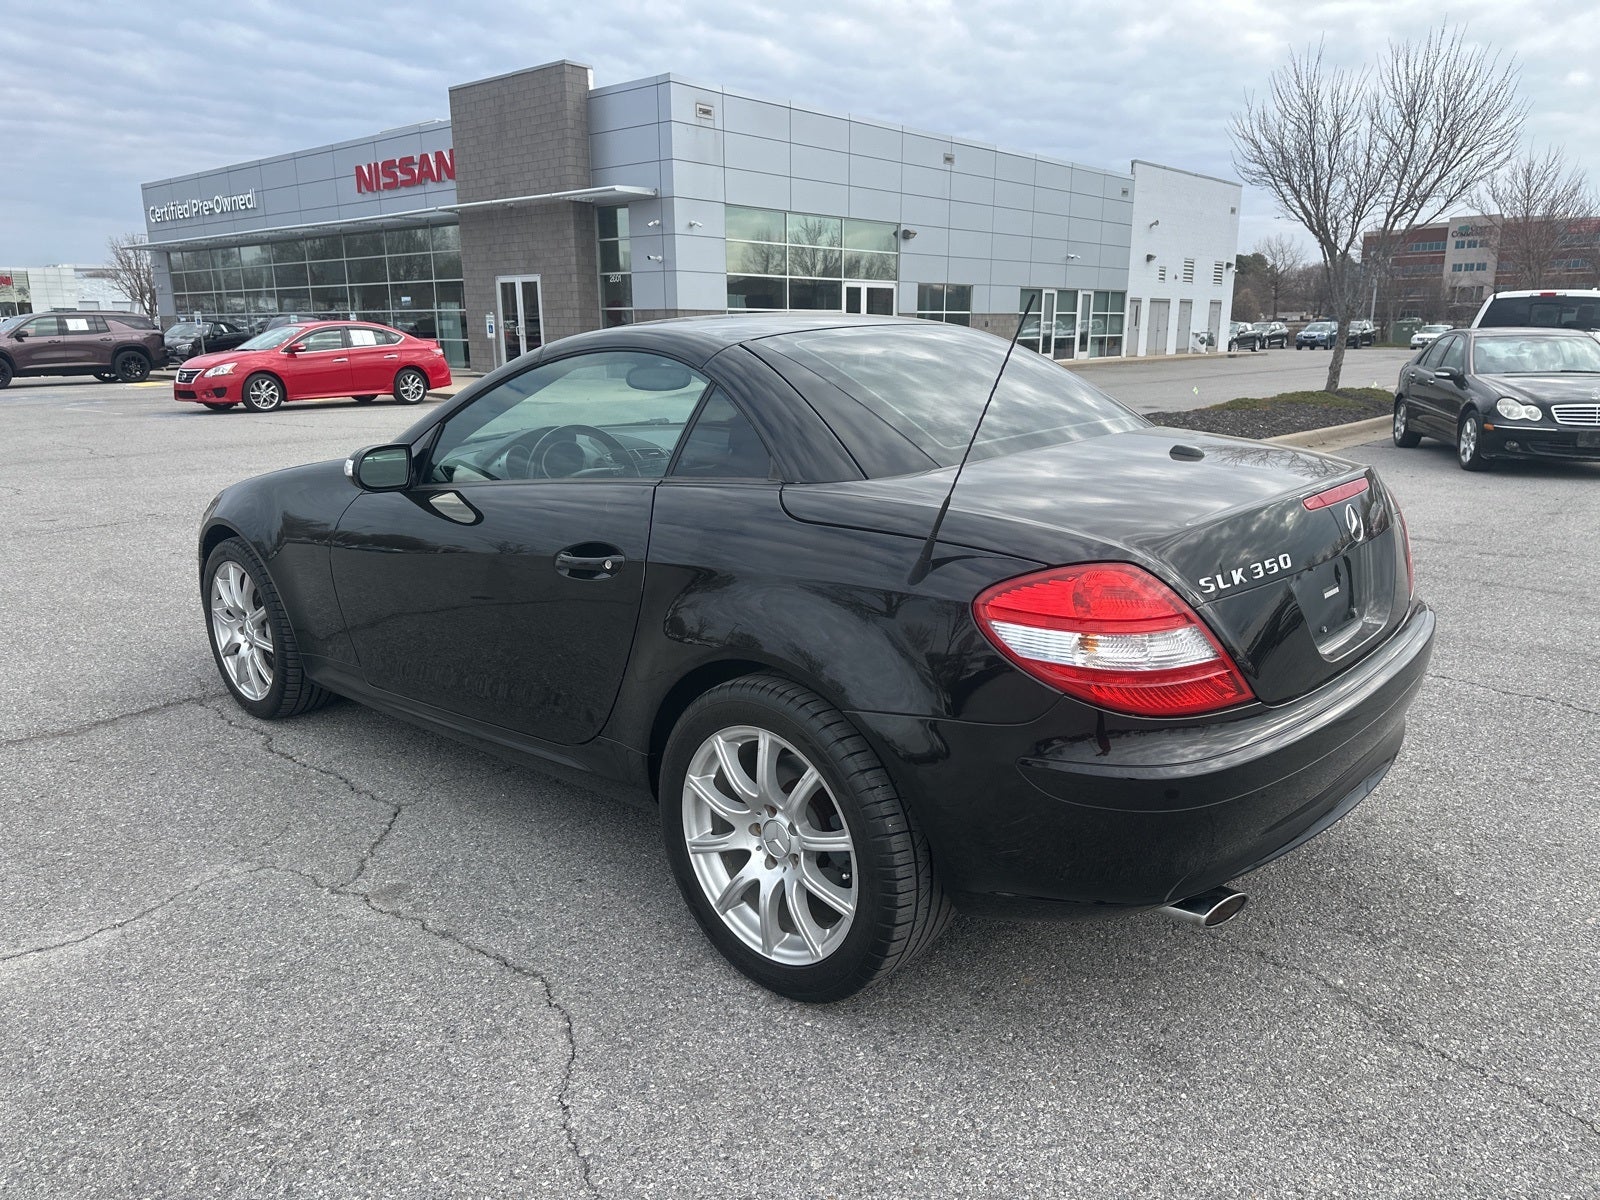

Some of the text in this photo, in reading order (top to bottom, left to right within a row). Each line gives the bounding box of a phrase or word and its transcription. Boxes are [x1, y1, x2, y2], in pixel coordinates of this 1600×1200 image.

[355, 148, 456, 194] NISSAN
[149, 188, 257, 223] Certified Pre-Owned
[1198, 553, 1293, 594] SLK 350
